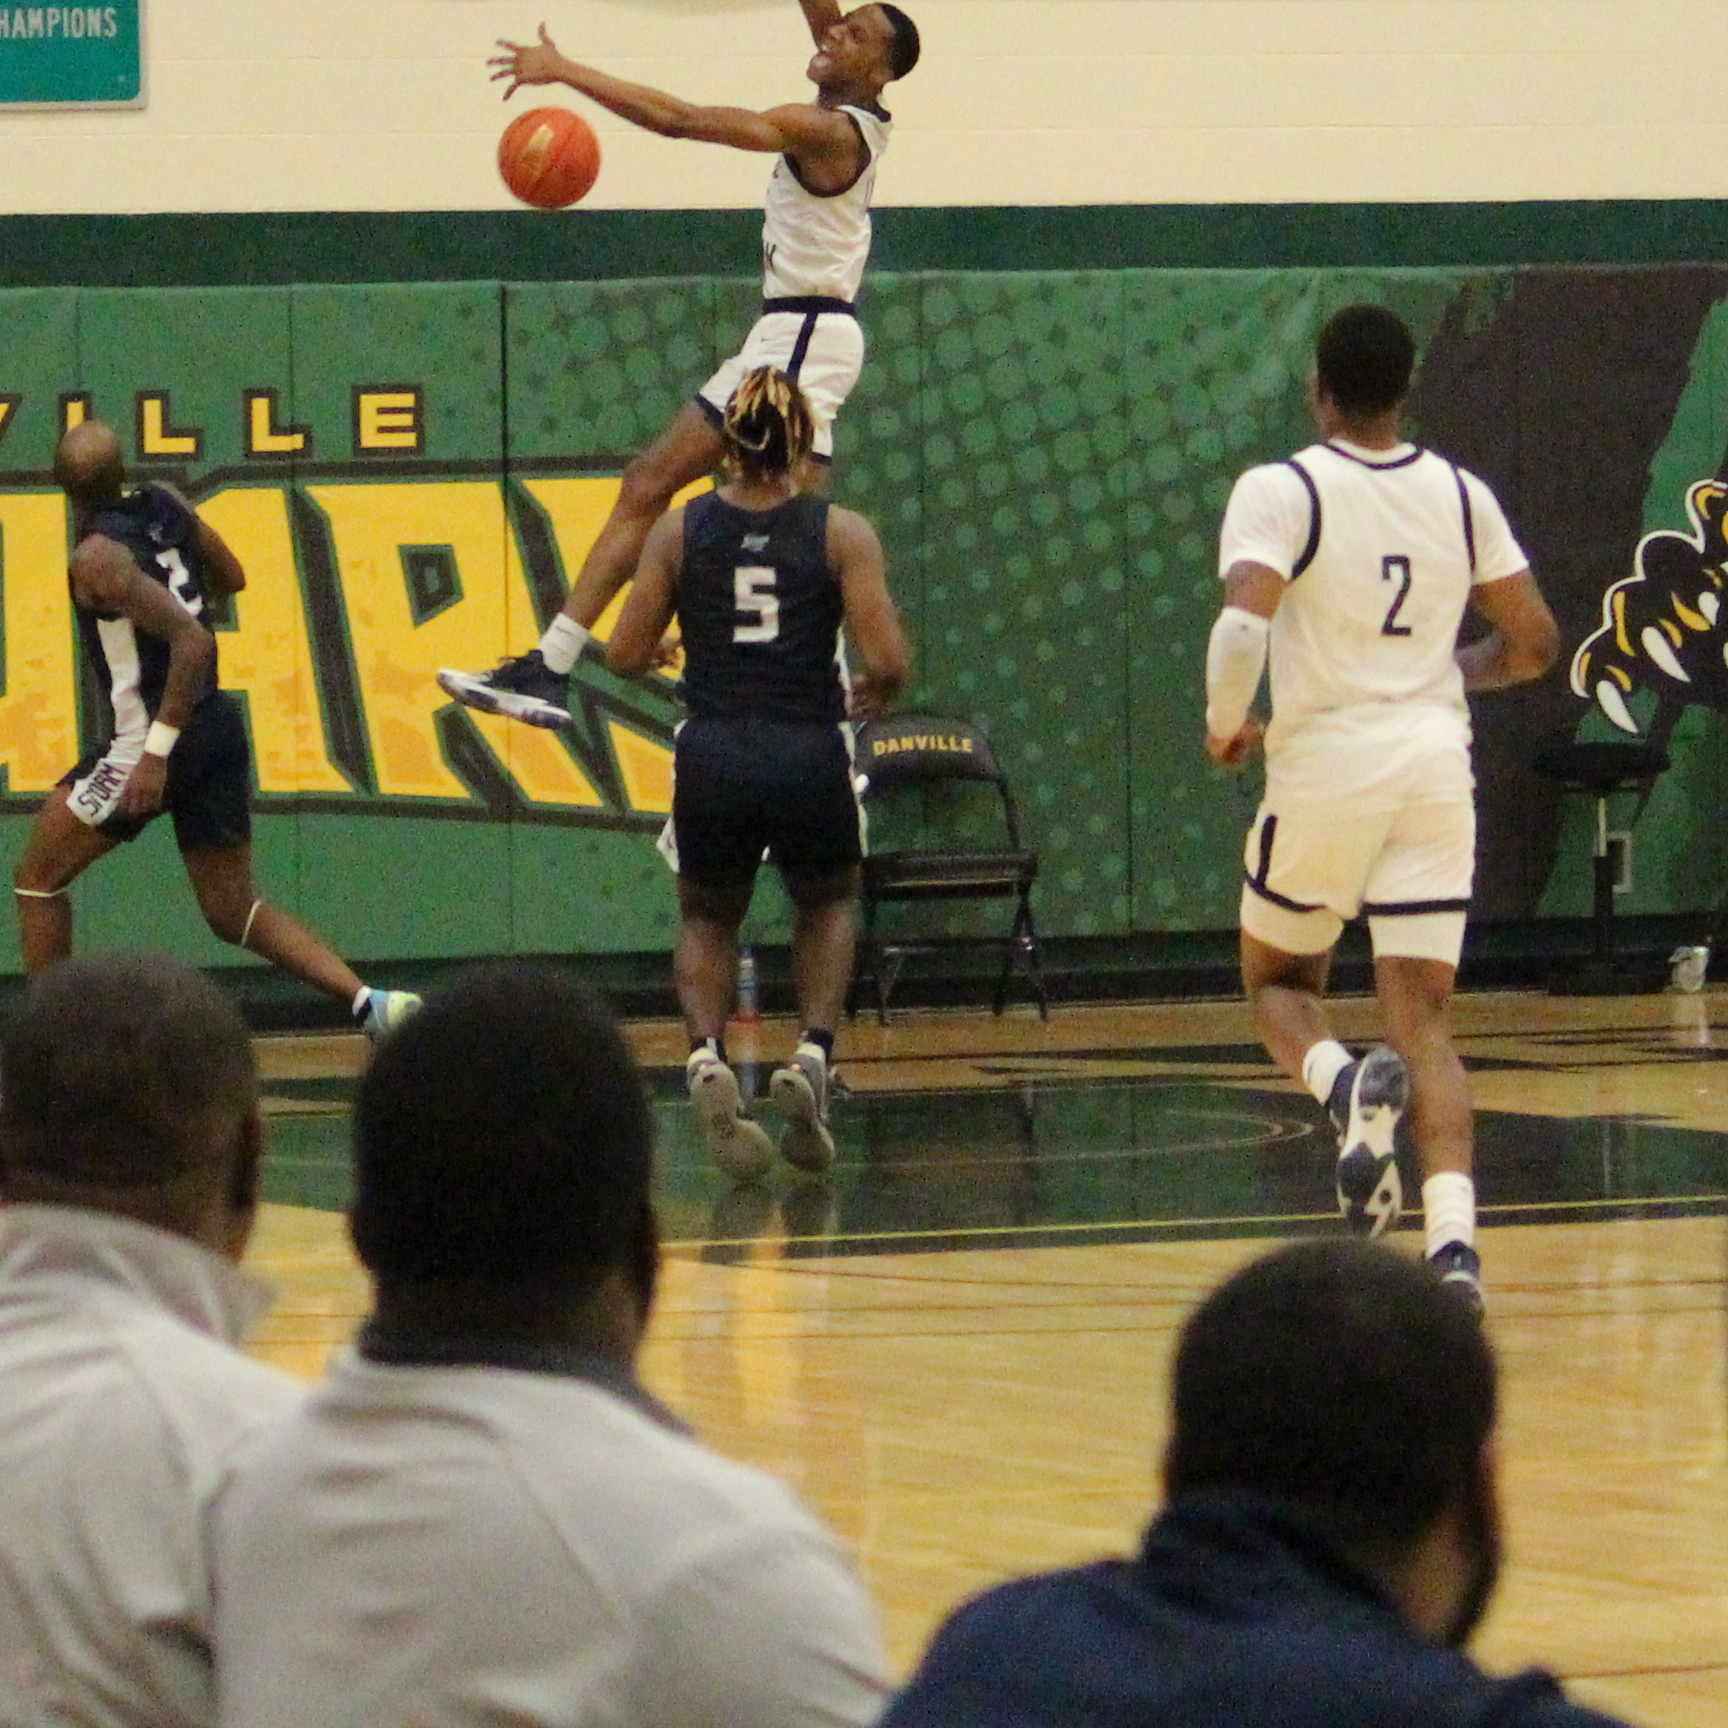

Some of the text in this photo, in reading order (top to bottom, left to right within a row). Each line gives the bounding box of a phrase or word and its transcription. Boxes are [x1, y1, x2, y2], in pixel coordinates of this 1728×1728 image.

[733, 566, 780, 643] 5
[1381, 554, 1412, 636] 2
[873, 734, 973, 757] DANVILLE
